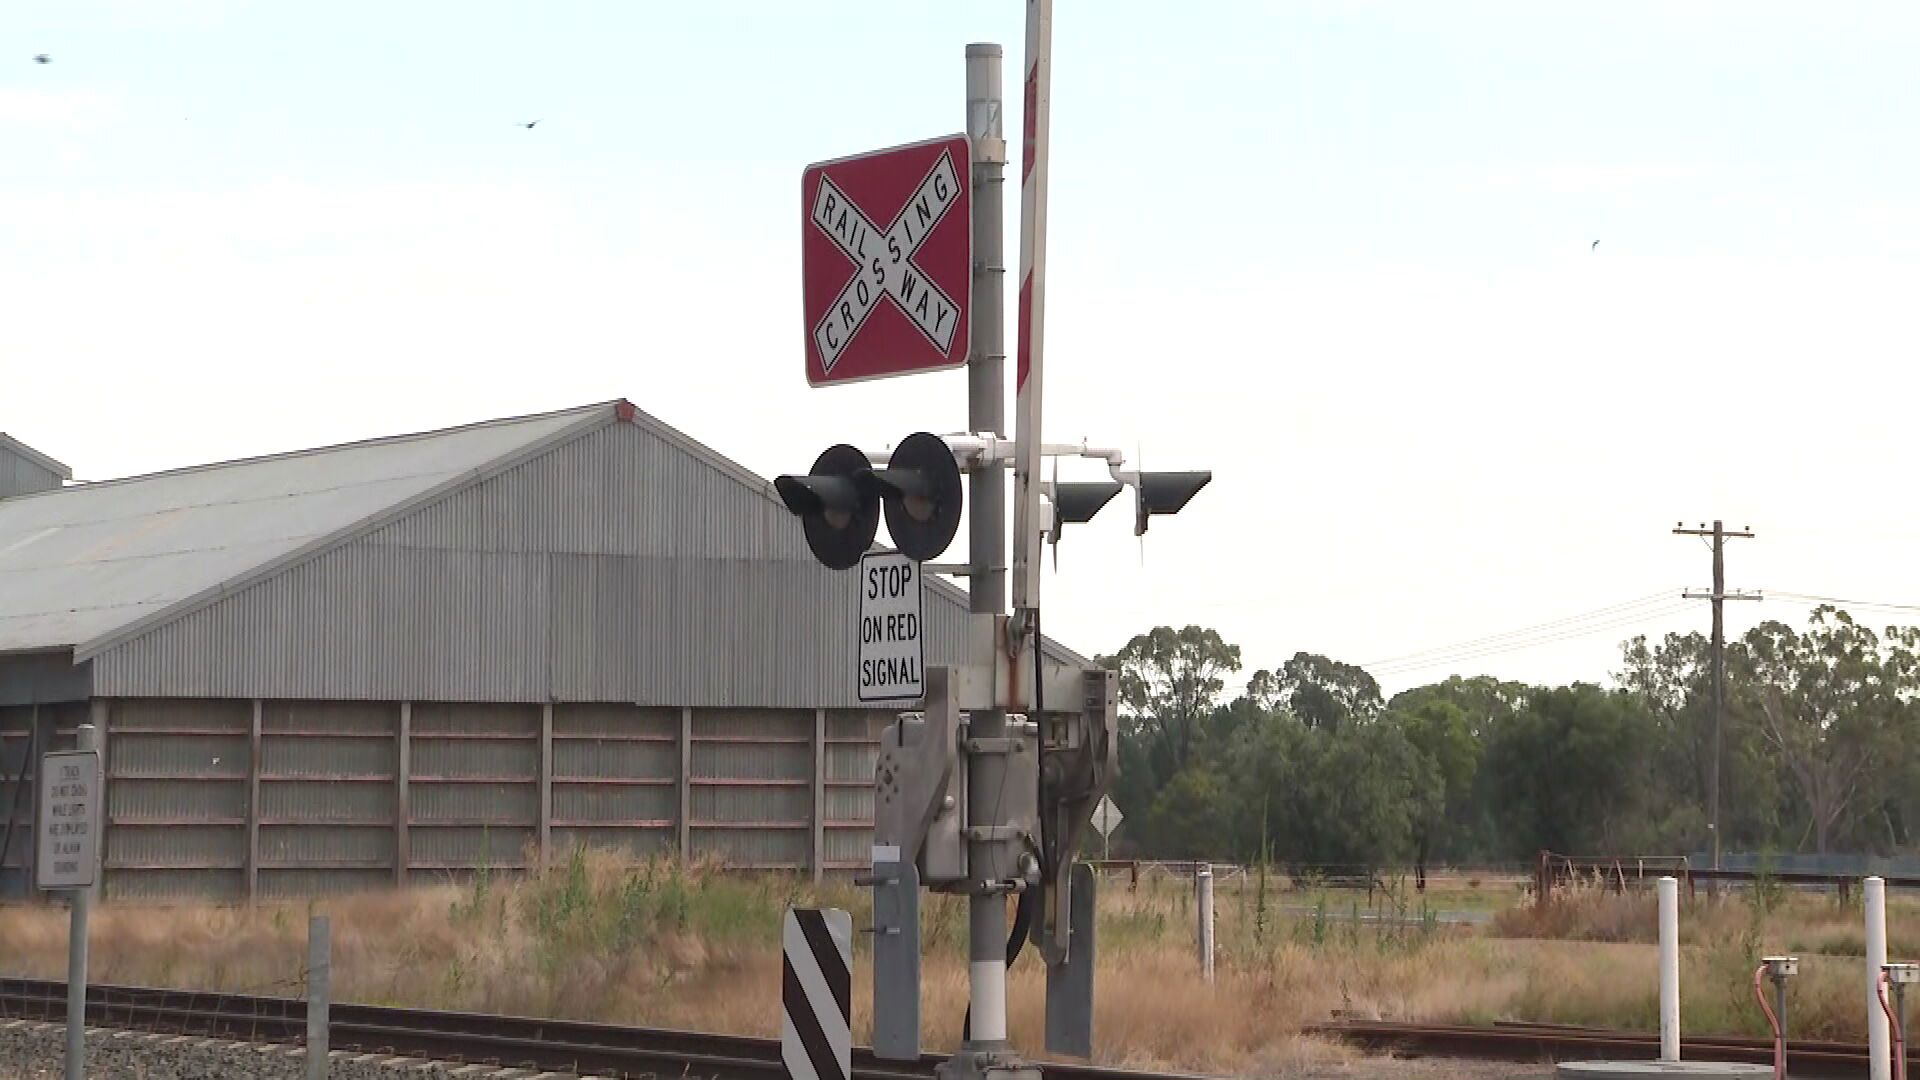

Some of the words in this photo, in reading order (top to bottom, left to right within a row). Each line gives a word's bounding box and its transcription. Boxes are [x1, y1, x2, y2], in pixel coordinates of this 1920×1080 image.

[825, 173, 948, 351] CROSSING
[868, 565, 912, 600] STOP
[862, 616, 882, 644] ON
[887, 613, 917, 642] RED
[862, 656, 920, 686] SIGNAL
